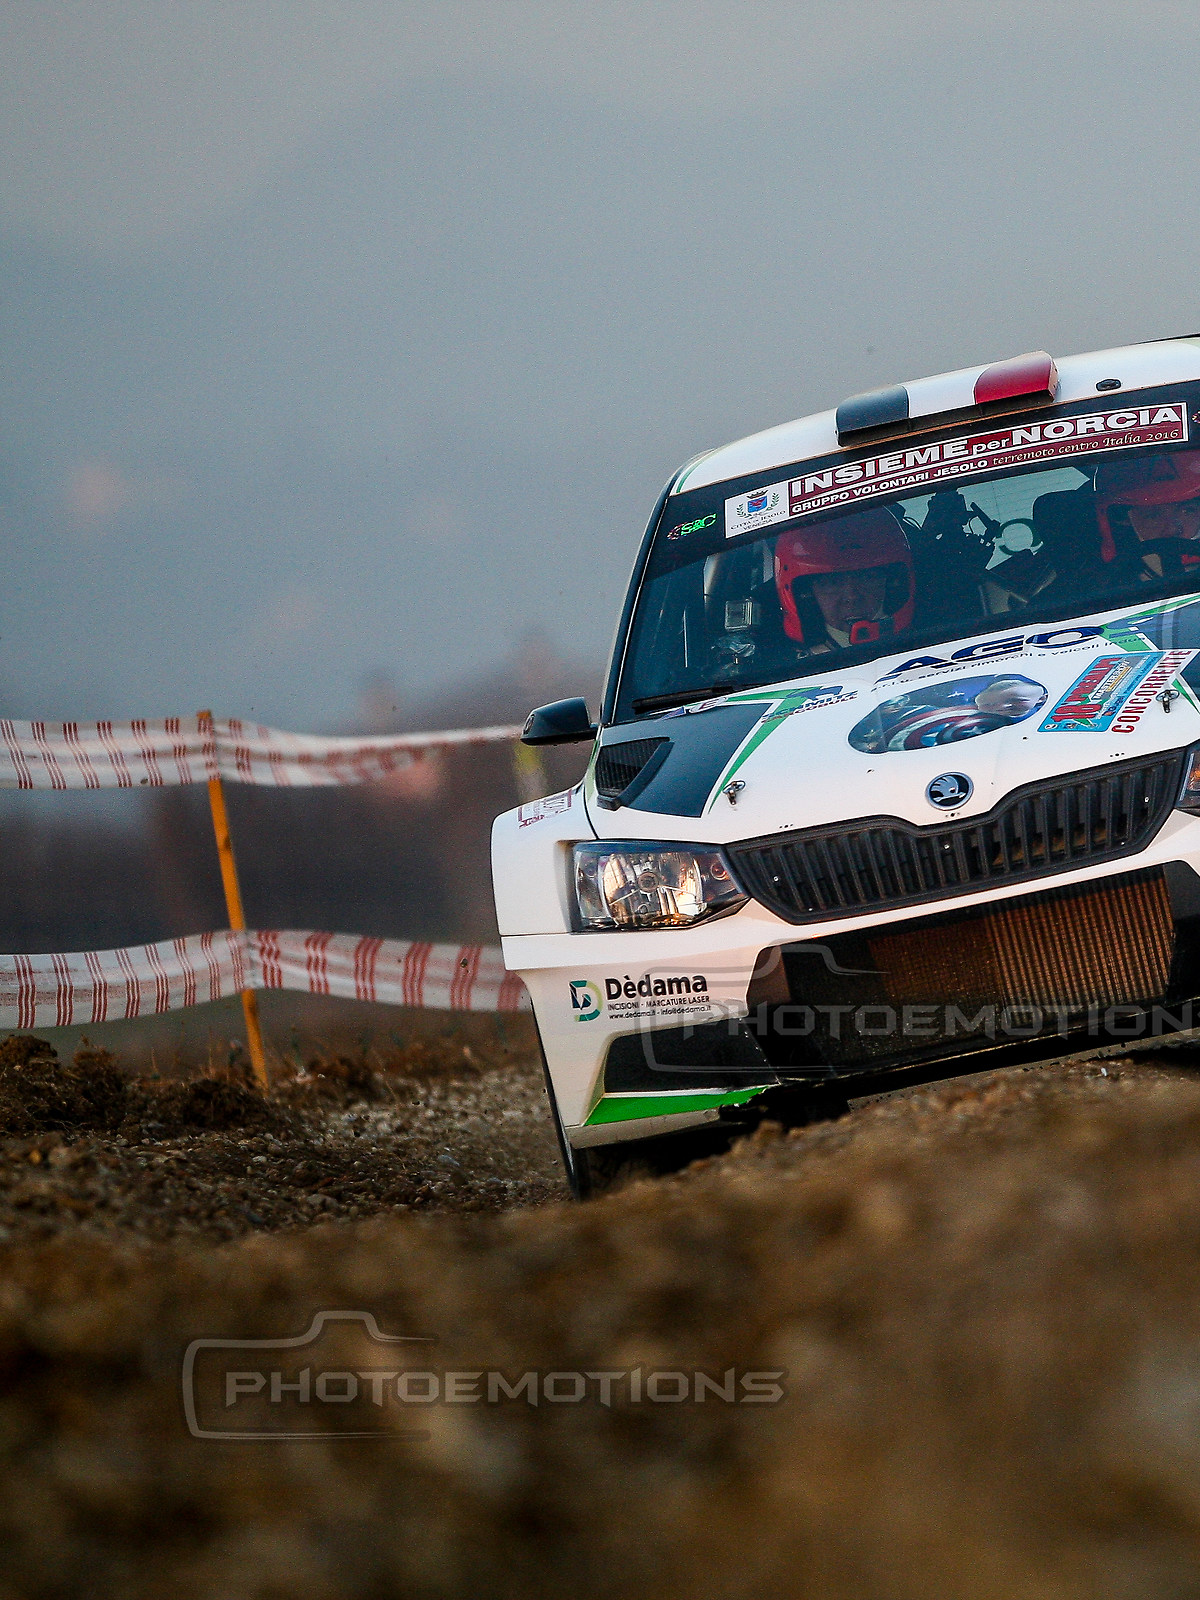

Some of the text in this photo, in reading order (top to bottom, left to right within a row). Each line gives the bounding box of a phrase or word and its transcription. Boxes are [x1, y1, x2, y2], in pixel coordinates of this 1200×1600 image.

[791, 407, 1182, 498] INSIEME per NORCIA
[791, 428, 1180, 514] GRUPPO VOLONTARI JESOLO terremoto centro Italia 2016
[873, 626, 1105, 686] AGO
[1111, 650, 1192, 733] CONCORRENTE
[604, 974, 708, 1001] Dèdama
[607, 1002, 640, 1012] INCISIONI
[645, 997, 688, 1008] MARCATURE
[688, 995, 710, 1004] LASER
[608, 1009, 656, 1020] www.dedama.it
